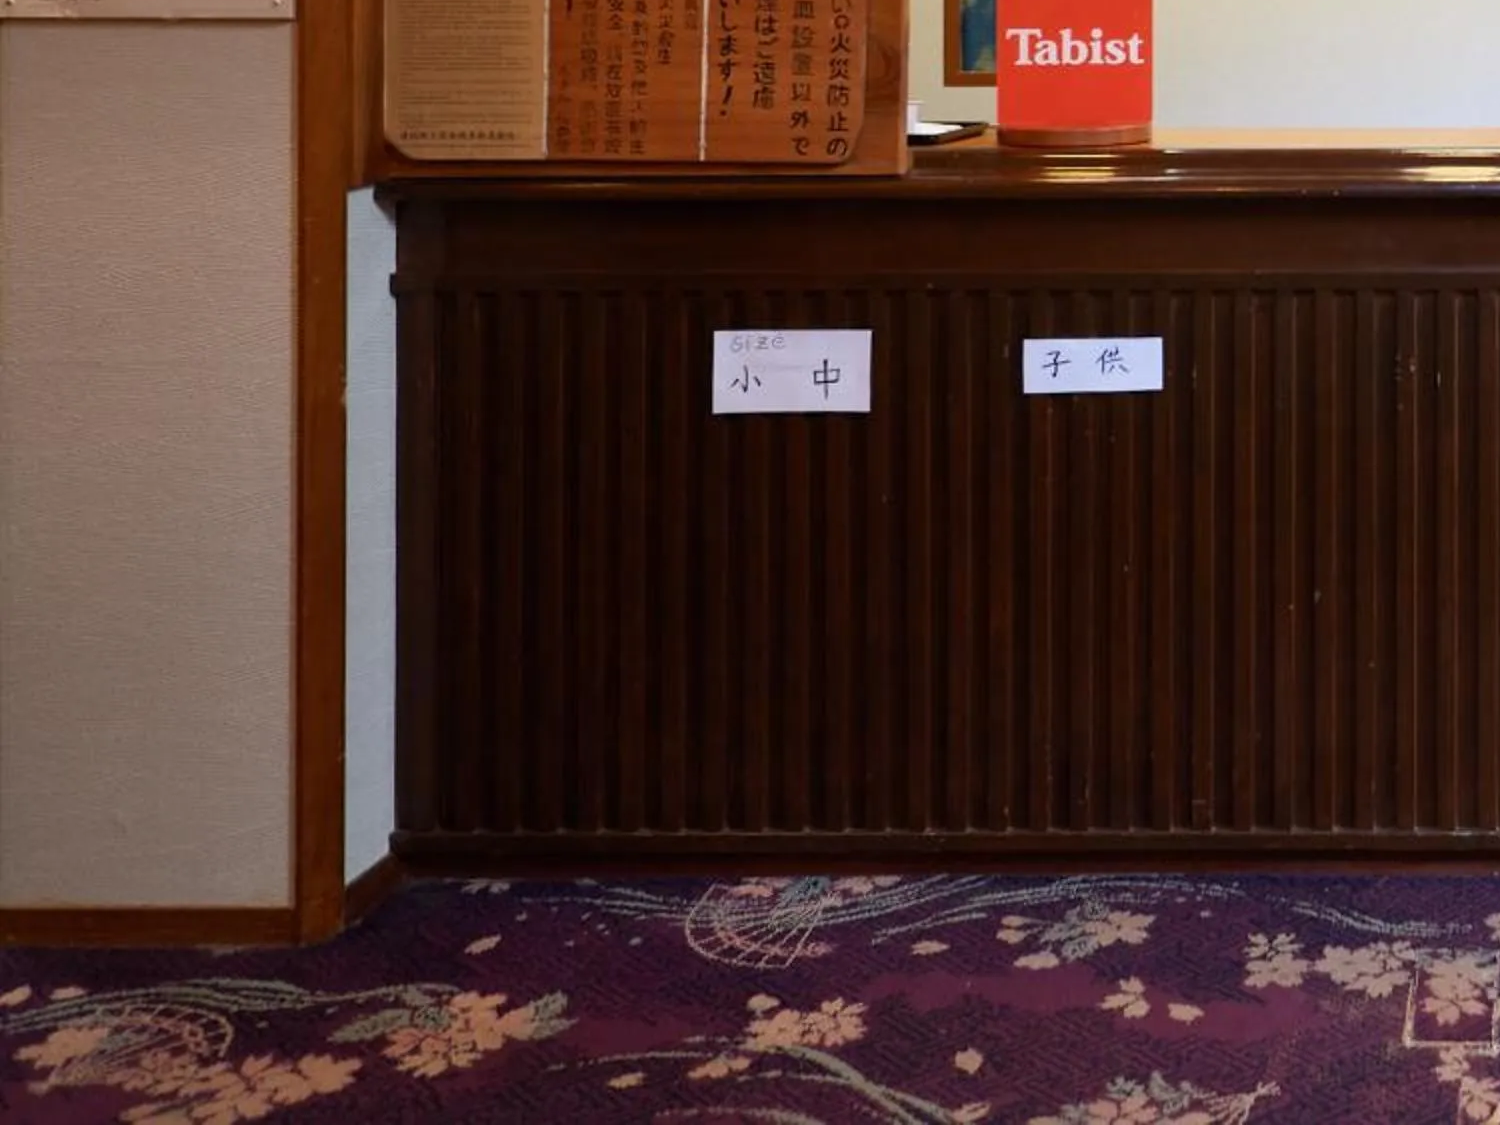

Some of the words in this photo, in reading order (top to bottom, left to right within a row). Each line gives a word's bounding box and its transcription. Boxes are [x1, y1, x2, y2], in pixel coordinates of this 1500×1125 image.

[1005, 28, 1145, 66] Tabist
[730, 364, 761, 393] 小
[813, 358, 841, 400] 中
